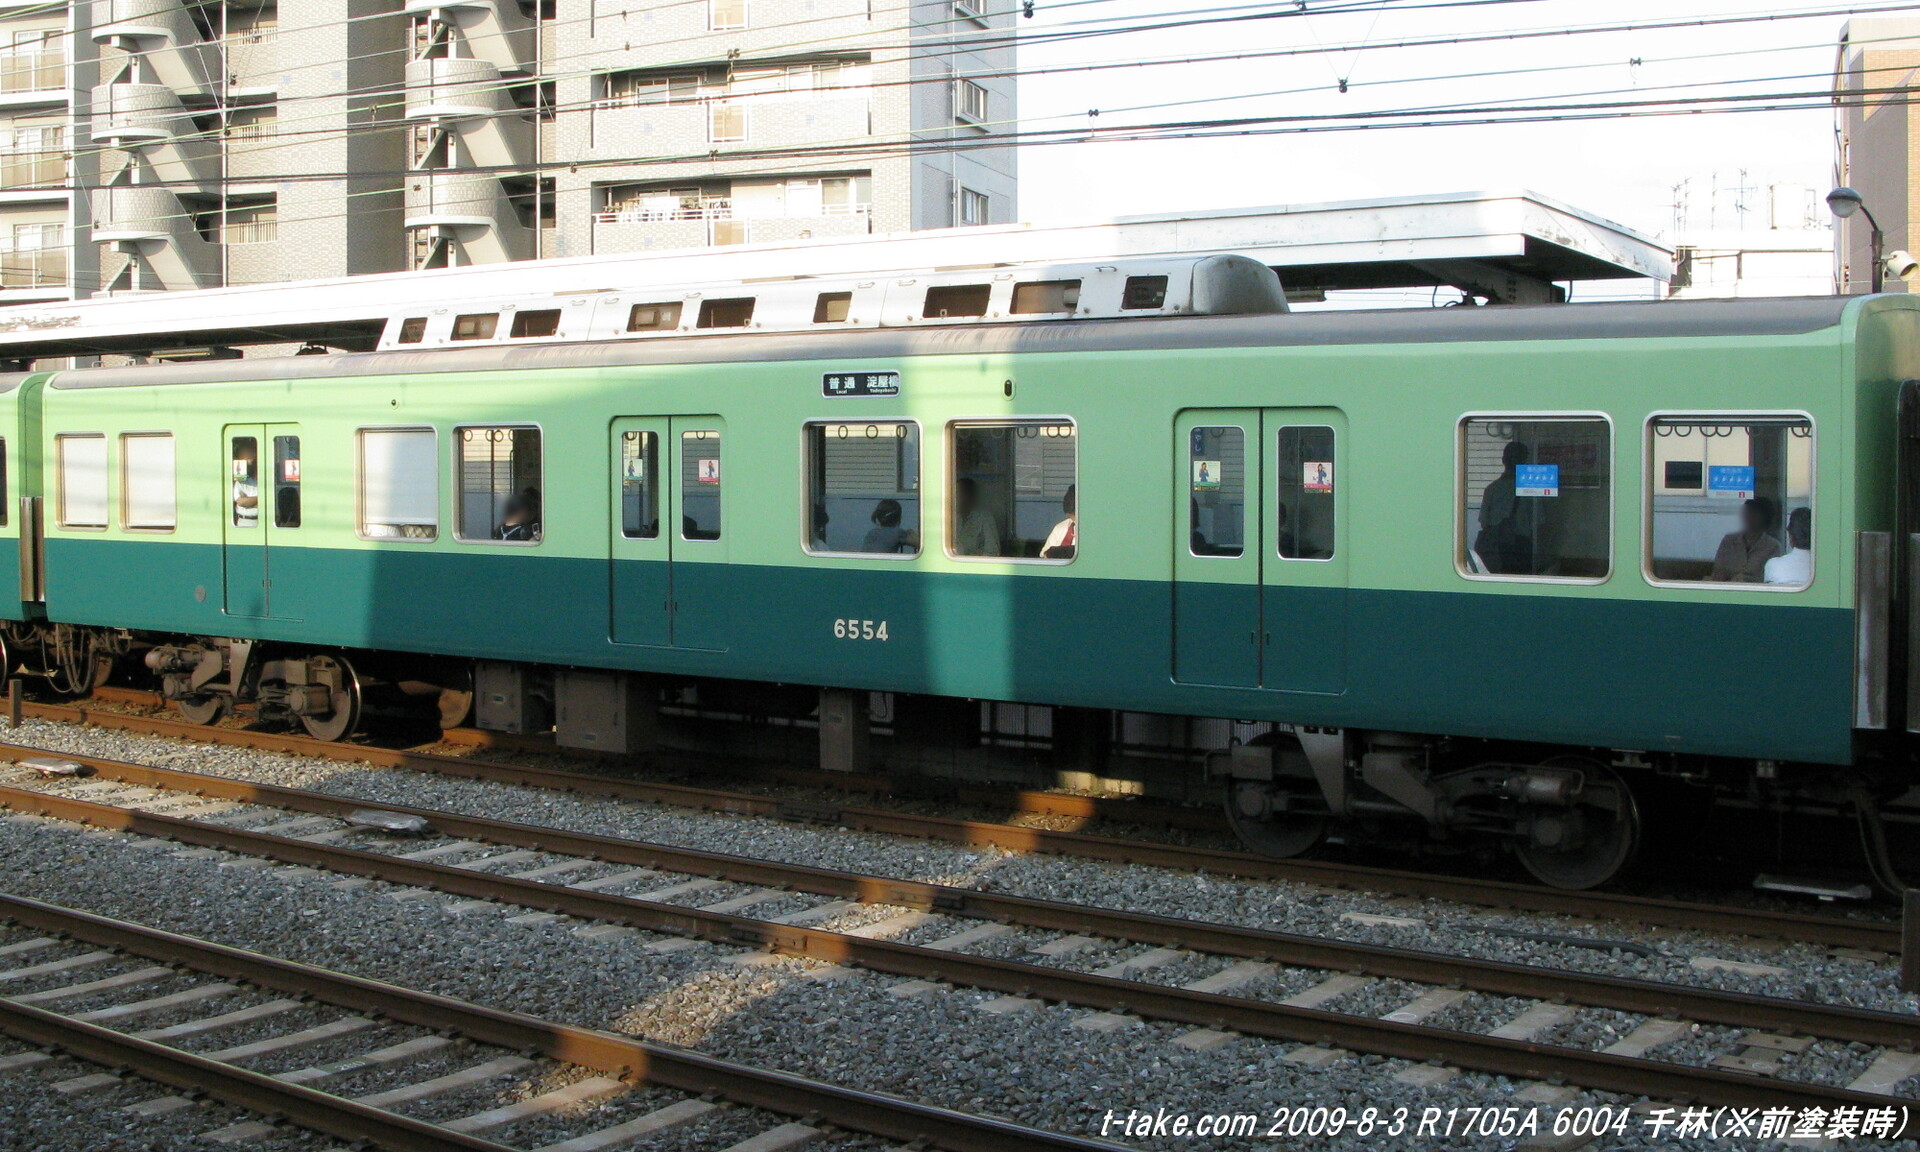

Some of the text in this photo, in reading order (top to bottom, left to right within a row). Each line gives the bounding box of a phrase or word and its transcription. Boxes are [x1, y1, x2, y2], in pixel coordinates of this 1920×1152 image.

[828, 375, 900, 390] 普通 淀屋橋
[833, 618, 889, 641] 6554
